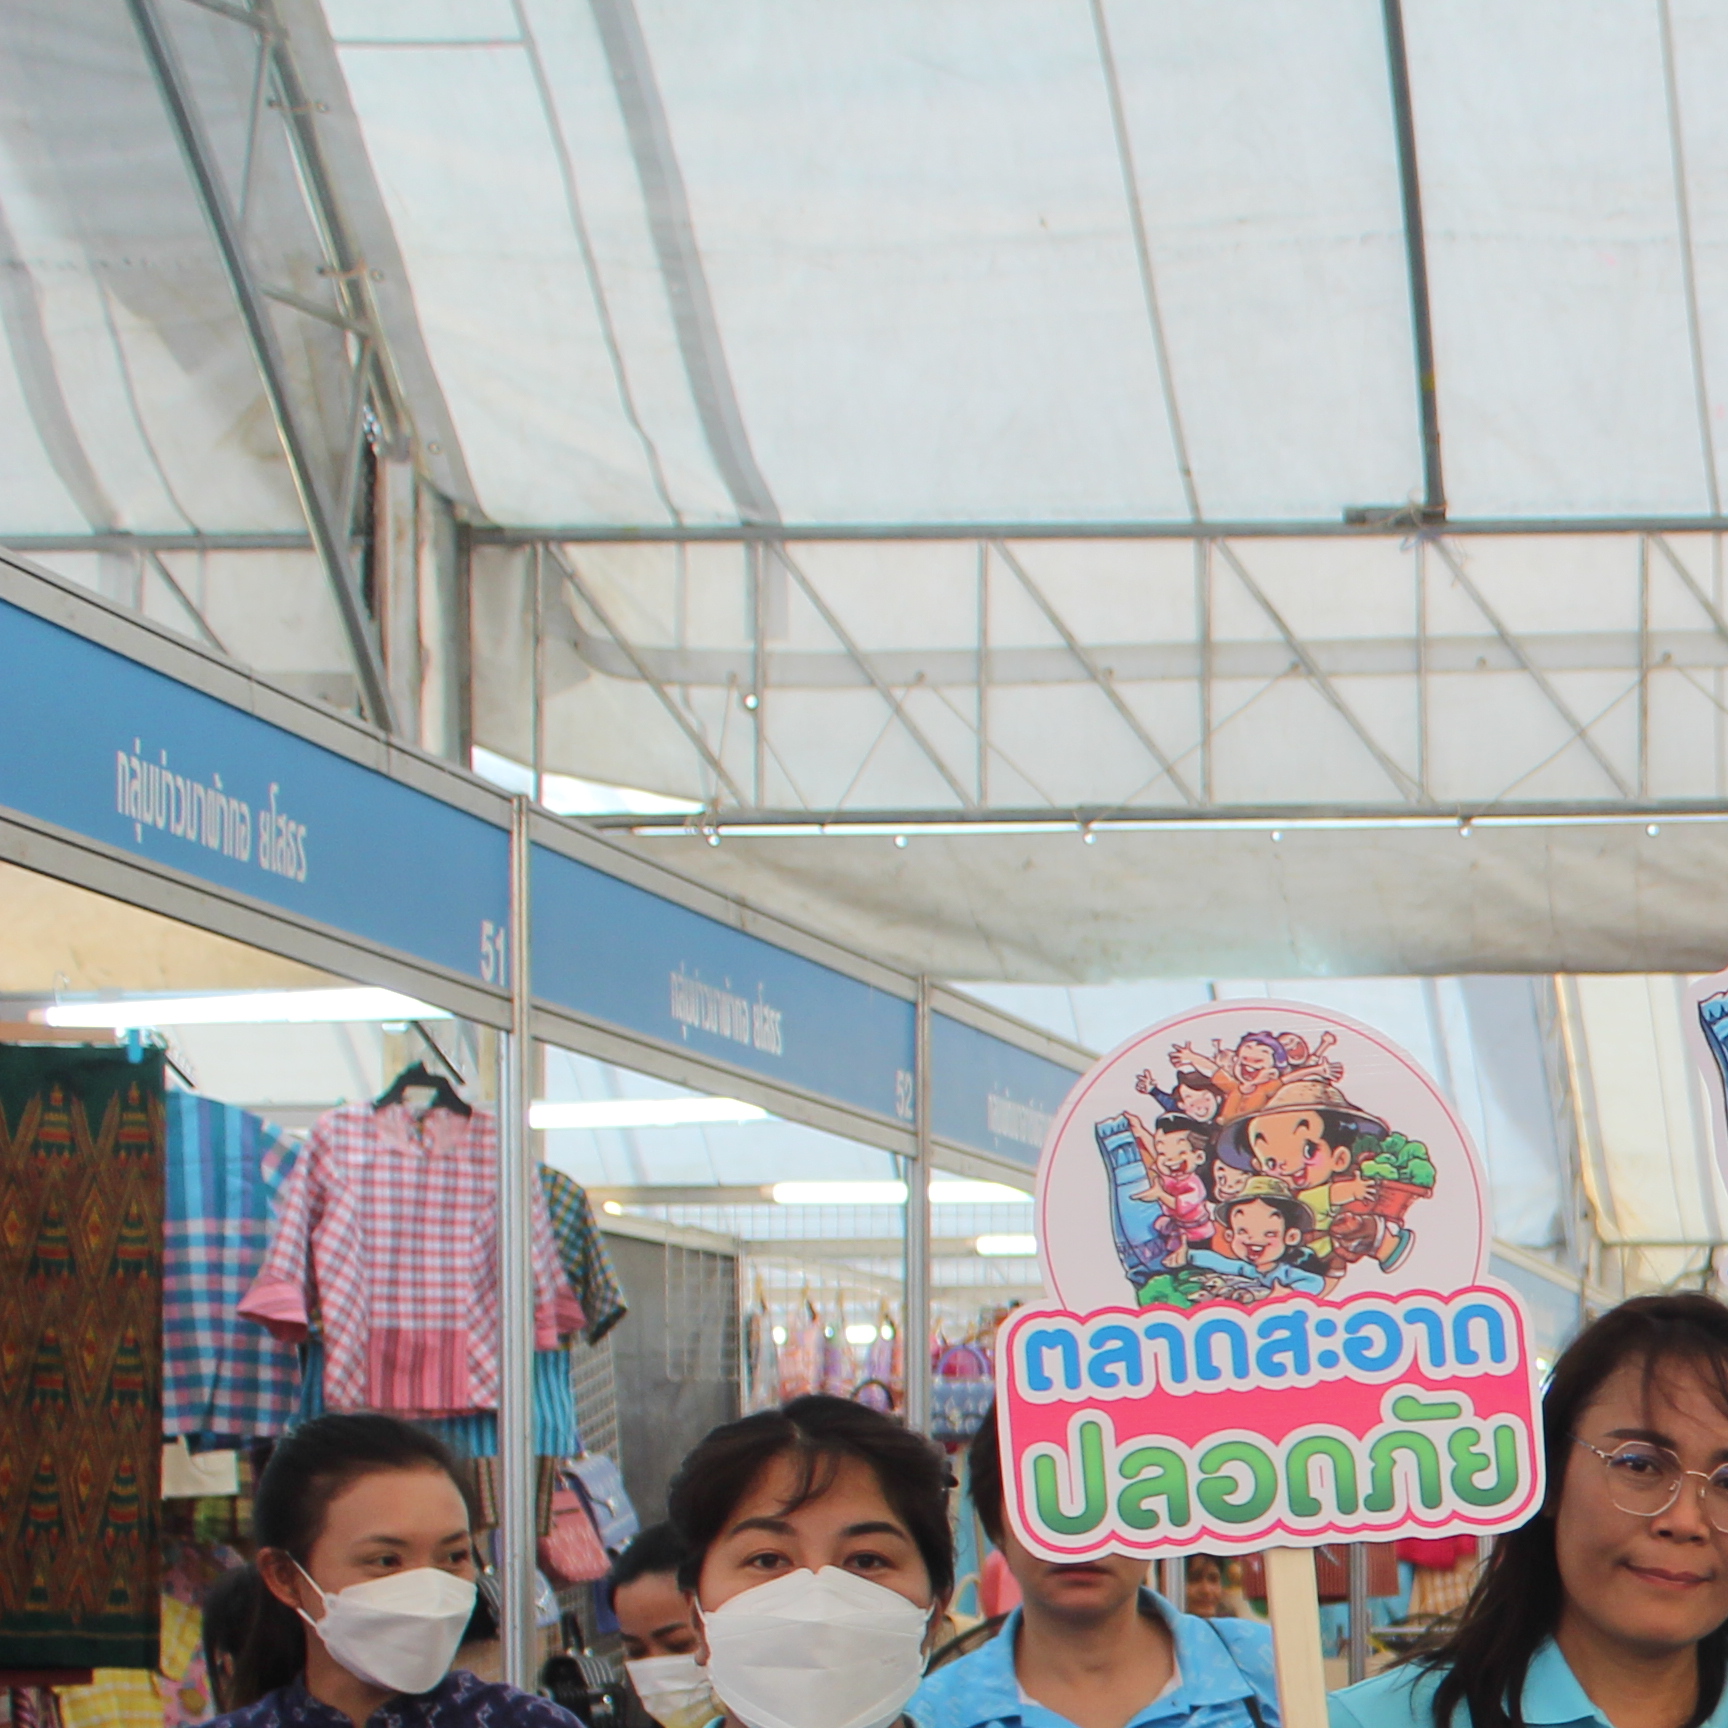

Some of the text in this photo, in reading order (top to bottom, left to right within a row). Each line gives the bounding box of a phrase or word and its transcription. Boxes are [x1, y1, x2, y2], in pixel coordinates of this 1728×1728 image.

[480, 919, 505, 987] 51
[1026, 1301, 1507, 1391] ตลาดสะอาด
[1031, 1394, 1519, 1536] ปลอดภัย
